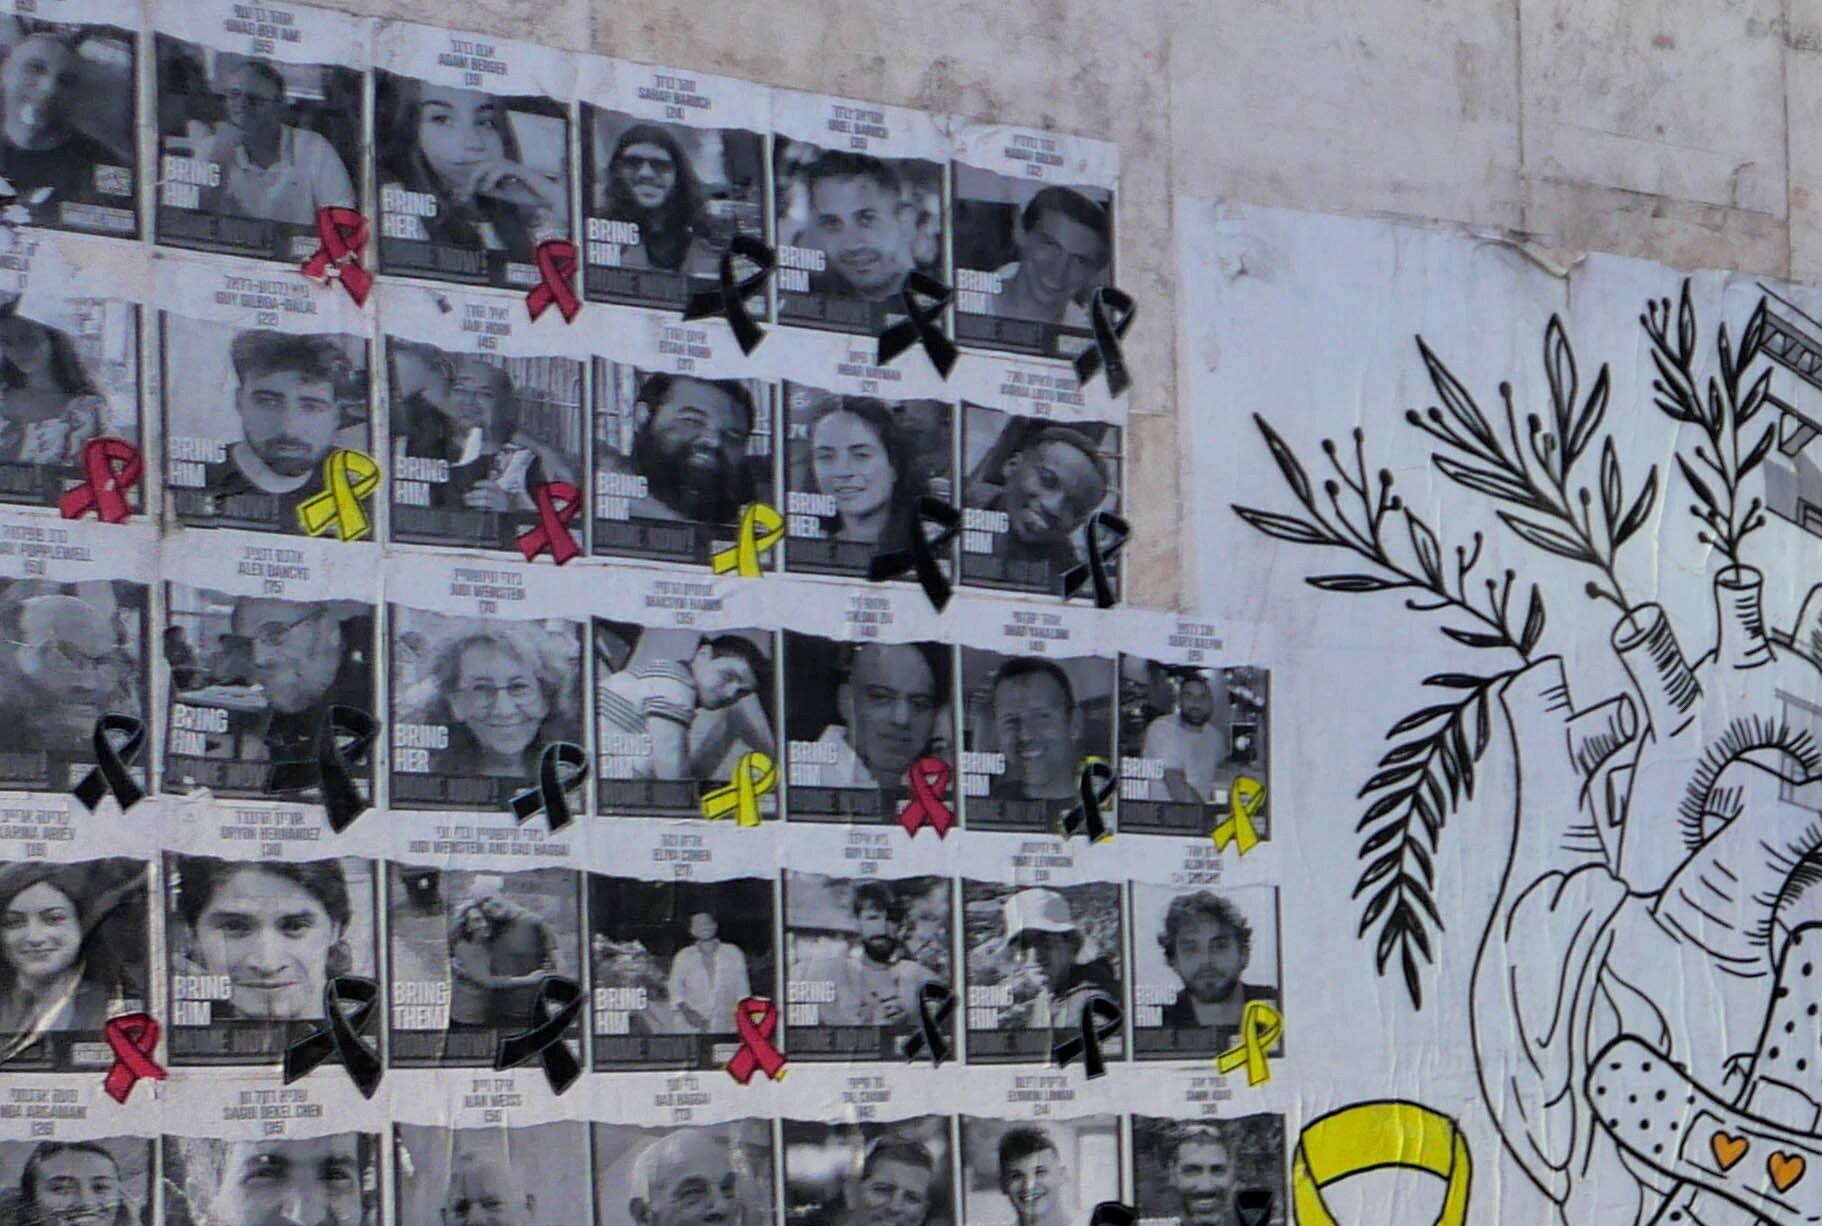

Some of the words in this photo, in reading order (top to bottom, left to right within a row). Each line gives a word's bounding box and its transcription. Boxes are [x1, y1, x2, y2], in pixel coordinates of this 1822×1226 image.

[381, 184, 437, 218] BRING
[588, 218, 640, 245] BRING
[394, 724, 449, 749] BRING
[173, 975, 232, 1000] BRING
